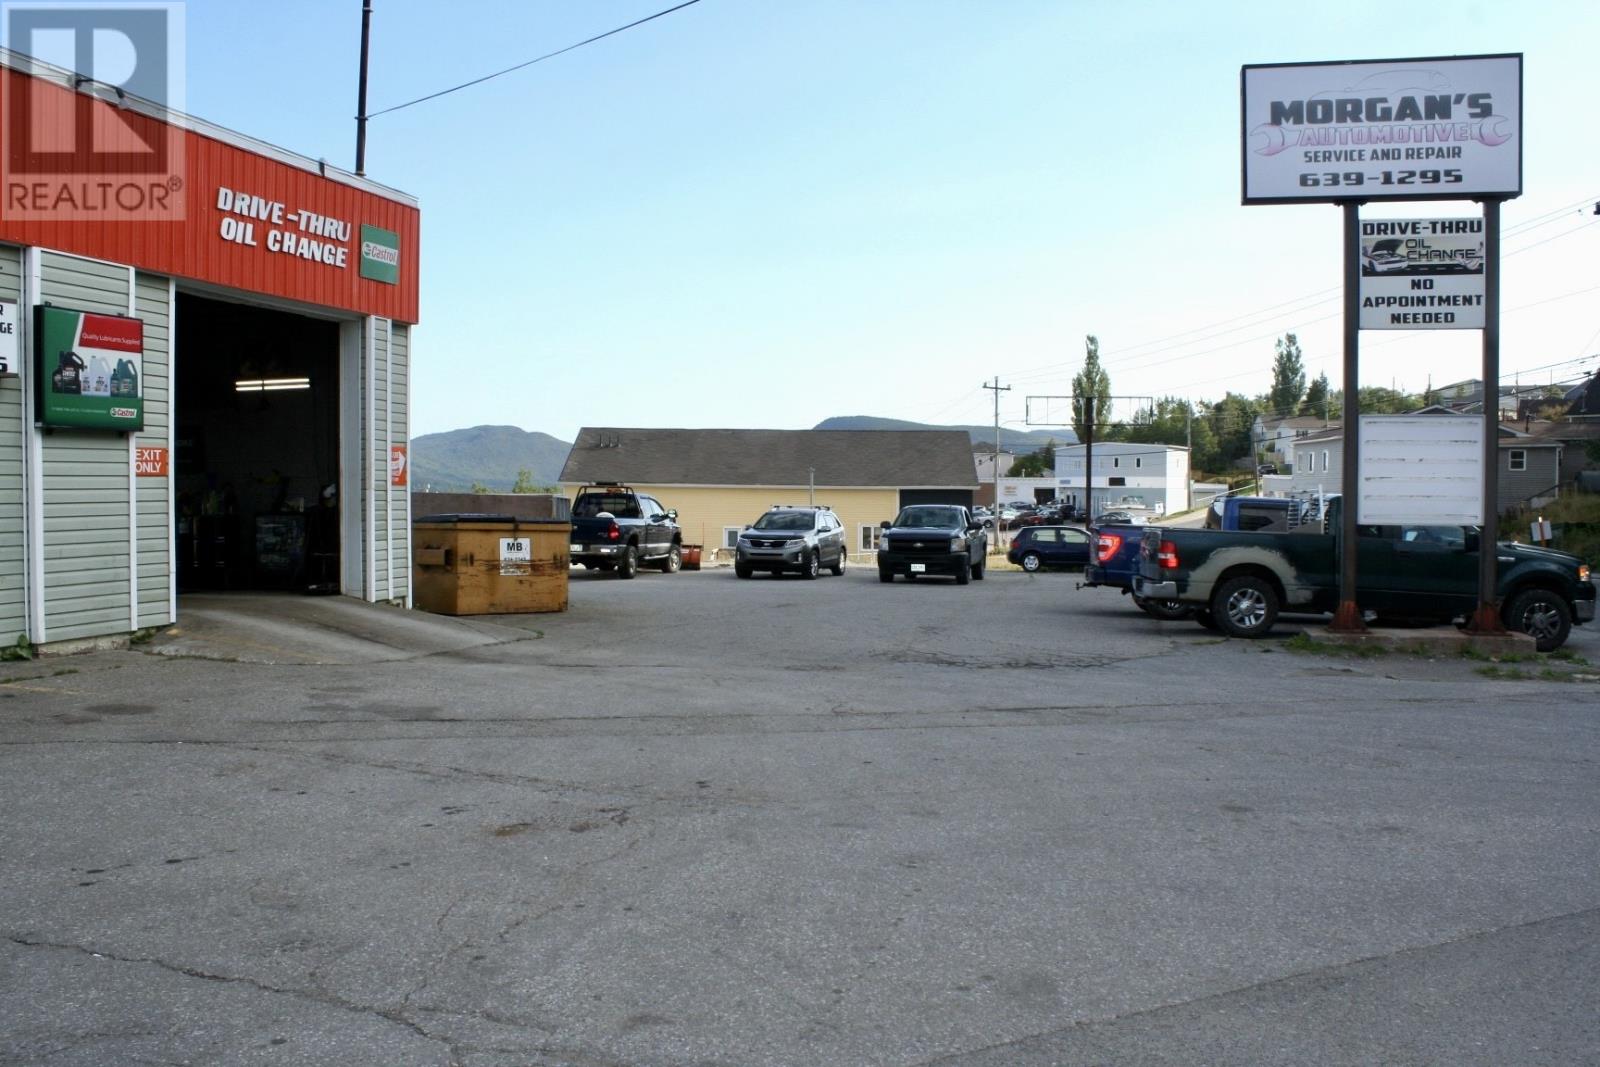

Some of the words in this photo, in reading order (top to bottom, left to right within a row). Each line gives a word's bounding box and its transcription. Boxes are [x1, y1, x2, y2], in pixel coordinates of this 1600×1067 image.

[1270, 93, 1492, 125] MORGAN'S
[1299, 122, 1469, 147] AUTOMOTIVE
[1303, 148, 1366, 163] SERVICE
[1370, 147, 1401, 161] AND
[1405, 146, 1462, 160] REPAIR
[1299, 169, 1463, 187] 639-1295
[1362, 220, 1482, 236] DRIVE-THRU
[220, 217, 257, 246] OIL
[267, 229, 348, 268] CHANGE
[1405, 239, 1432, 249] OIL
[371, 245, 397, 264] Castrol
[1406, 249, 1478, 262] CHANGE
[1411, 279, 1434, 290] NO
[1363, 295, 1483, 308] APPOINTMENT
[1390, 312, 1455, 324] NEEDED
[135, 449, 162, 461] EXIT
[135, 461, 162, 473] ONLY
[506, 542, 522, 551] MB
